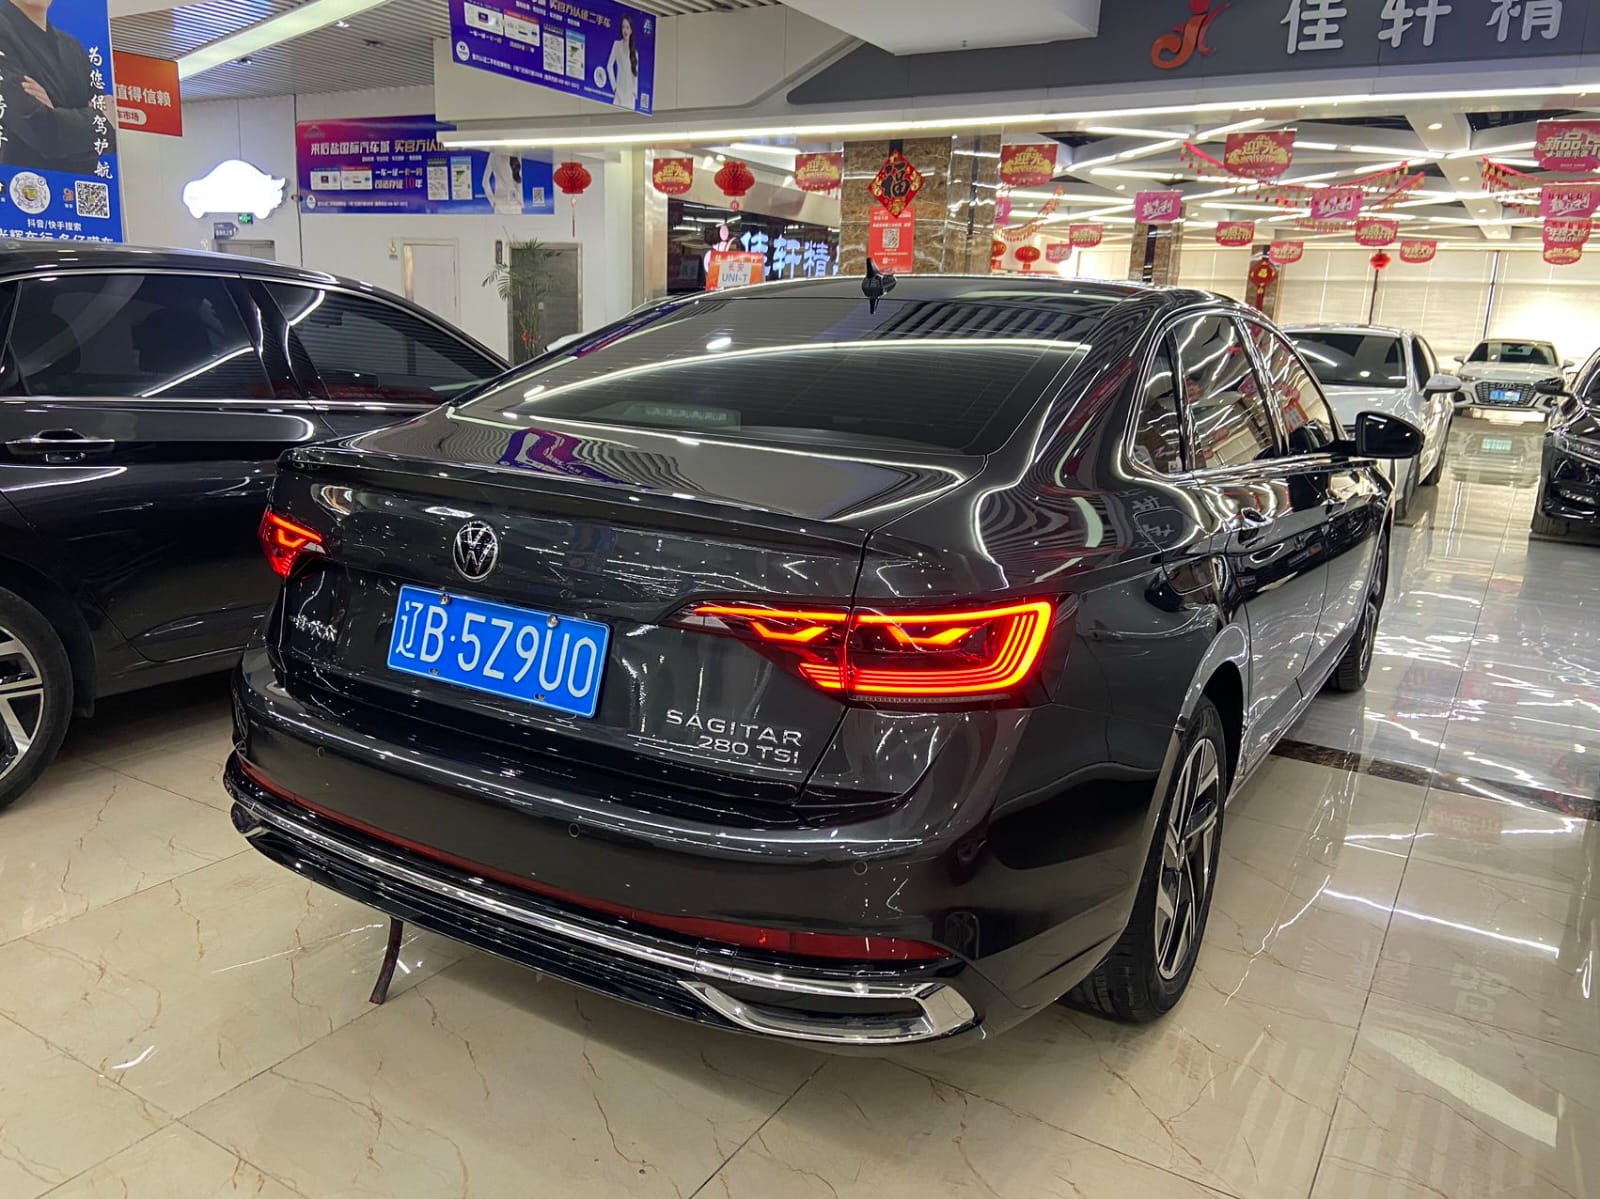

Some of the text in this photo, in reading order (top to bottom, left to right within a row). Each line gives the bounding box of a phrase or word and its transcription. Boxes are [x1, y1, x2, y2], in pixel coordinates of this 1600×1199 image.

[88, 46, 114, 179] 为您保驾护航
[881, 162, 910, 199] 福
[740, 230, 840, 280] 佳轩精
[666, 708, 802, 747] SAGITAR
[699, 735, 799, 765] 280 TSI
